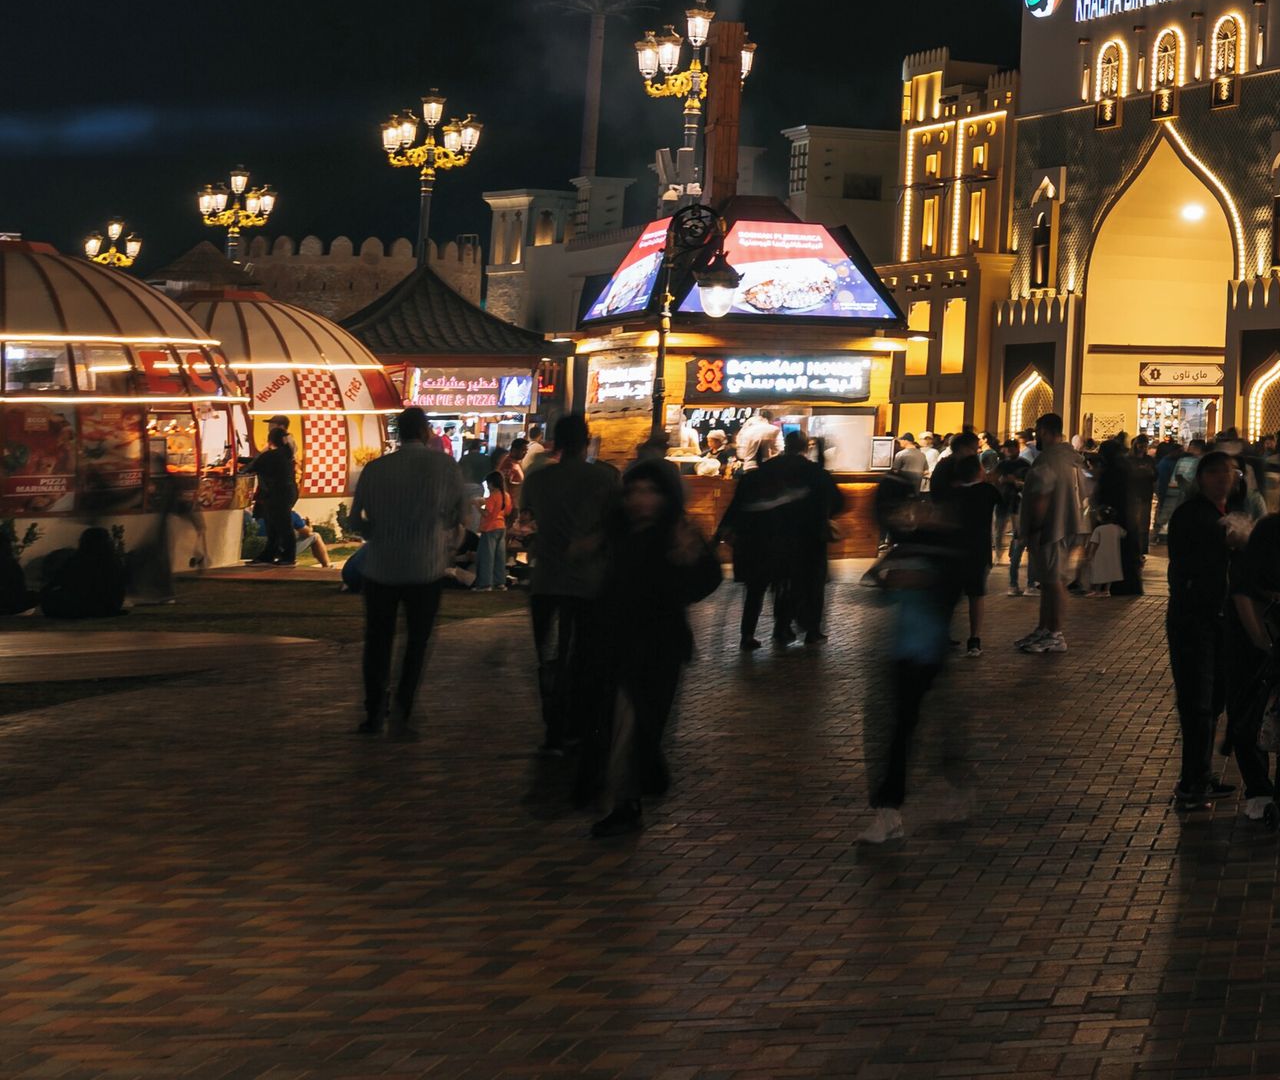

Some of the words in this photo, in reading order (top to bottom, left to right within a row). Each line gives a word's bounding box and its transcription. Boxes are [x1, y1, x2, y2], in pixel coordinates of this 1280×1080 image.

[255, 374, 291, 403] Hotdog
[344, 376, 363, 402] Fries
[435, 393, 454, 406] PIE
[454, 393, 465, 406] &
[466, 393, 498, 406] PIZZA
[39, 478, 68, 486] PIZZA
